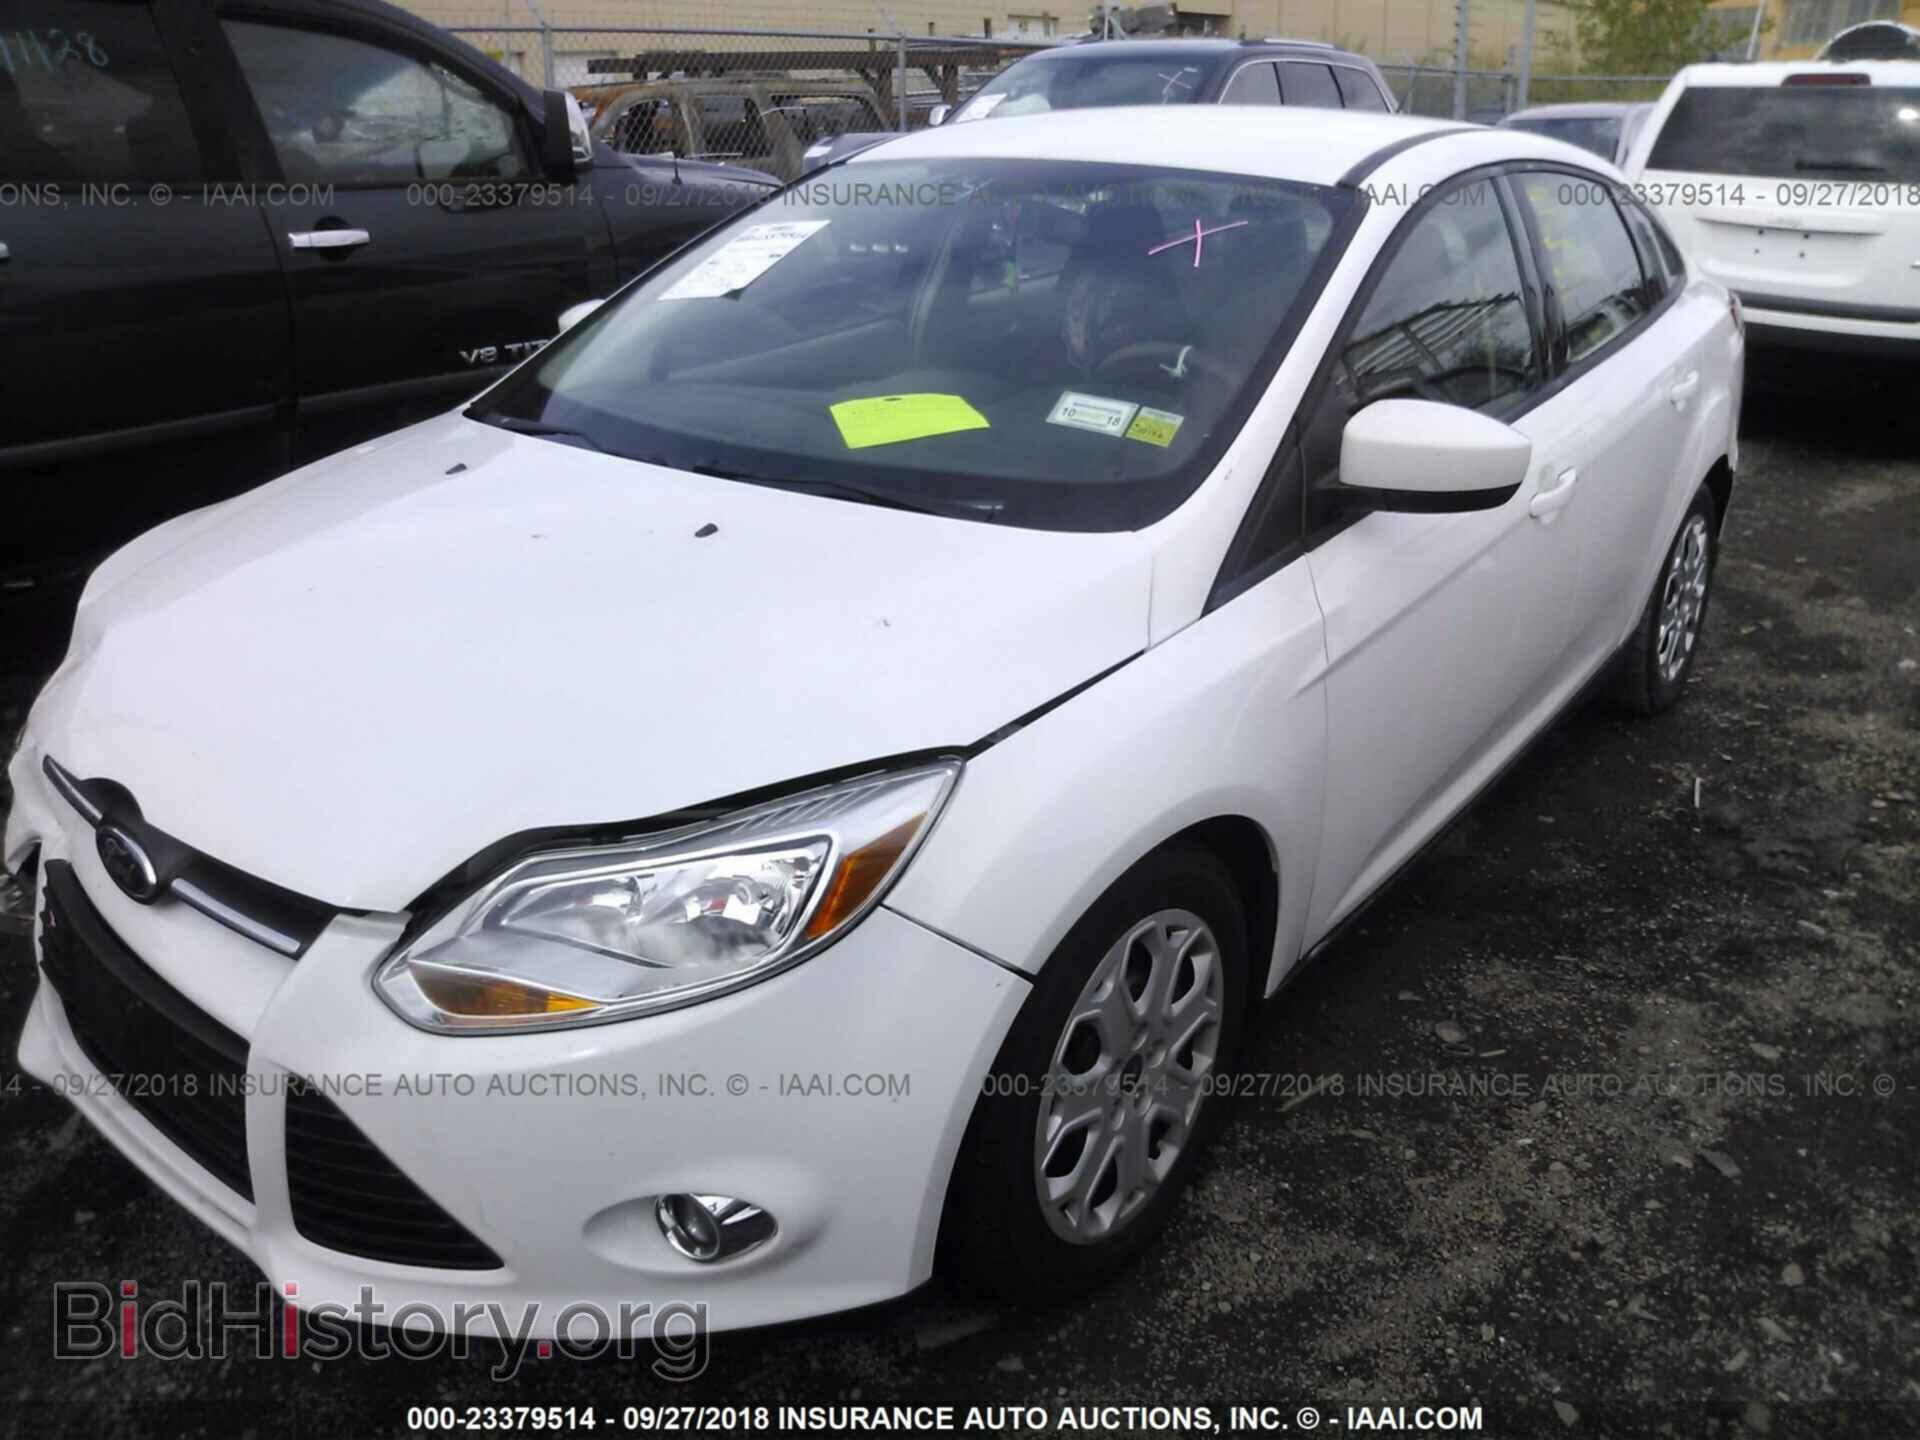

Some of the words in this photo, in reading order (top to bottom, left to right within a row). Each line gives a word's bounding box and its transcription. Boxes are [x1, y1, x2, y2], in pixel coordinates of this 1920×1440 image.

[458, 345, 497, 365] V8
[1062, 407, 1077, 418] 10
[1107, 415, 1122, 426] 18
